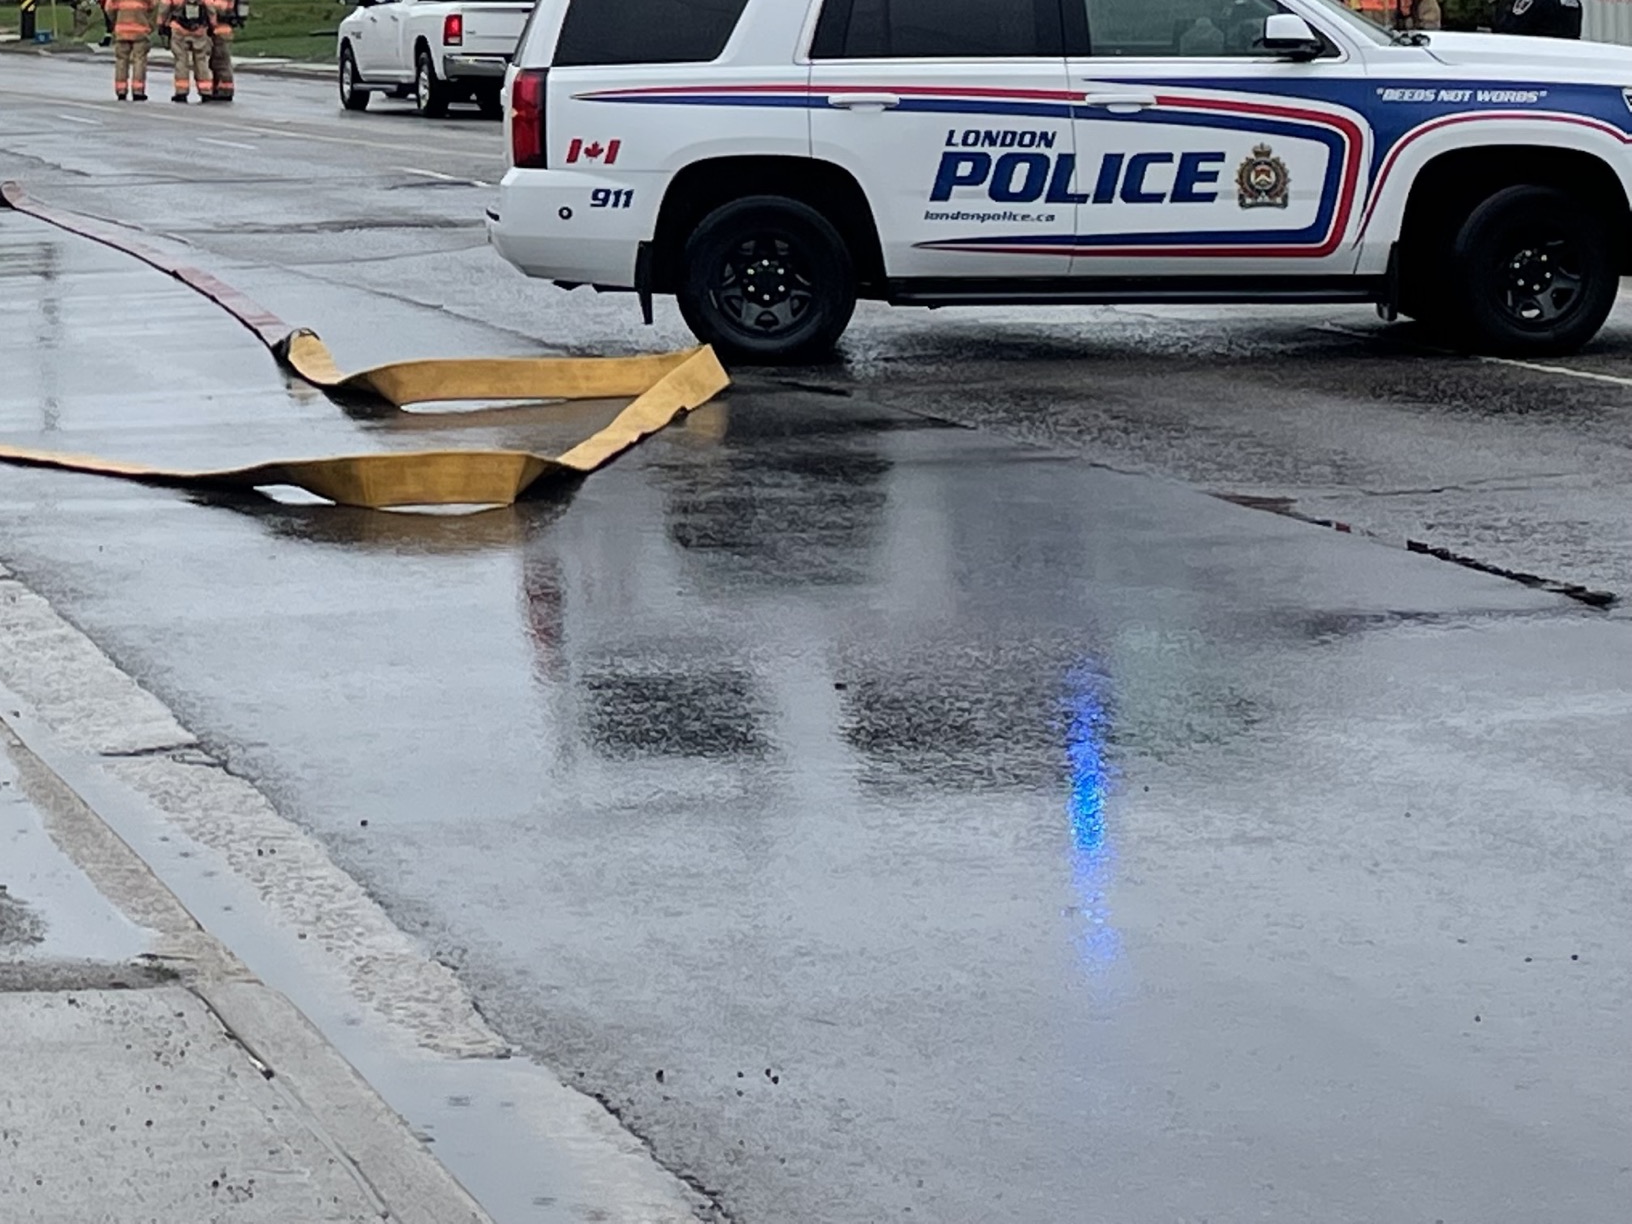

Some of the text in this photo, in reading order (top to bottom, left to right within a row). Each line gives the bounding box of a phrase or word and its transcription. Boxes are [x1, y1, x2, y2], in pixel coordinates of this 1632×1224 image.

[1437, 89, 1474, 102] NOT
[945, 129, 1057, 149] LONDON
[929, 151, 1226, 204] POLICE
[590, 188, 634, 209] 911
[924, 209, 1056, 223] londonpolice.ca
